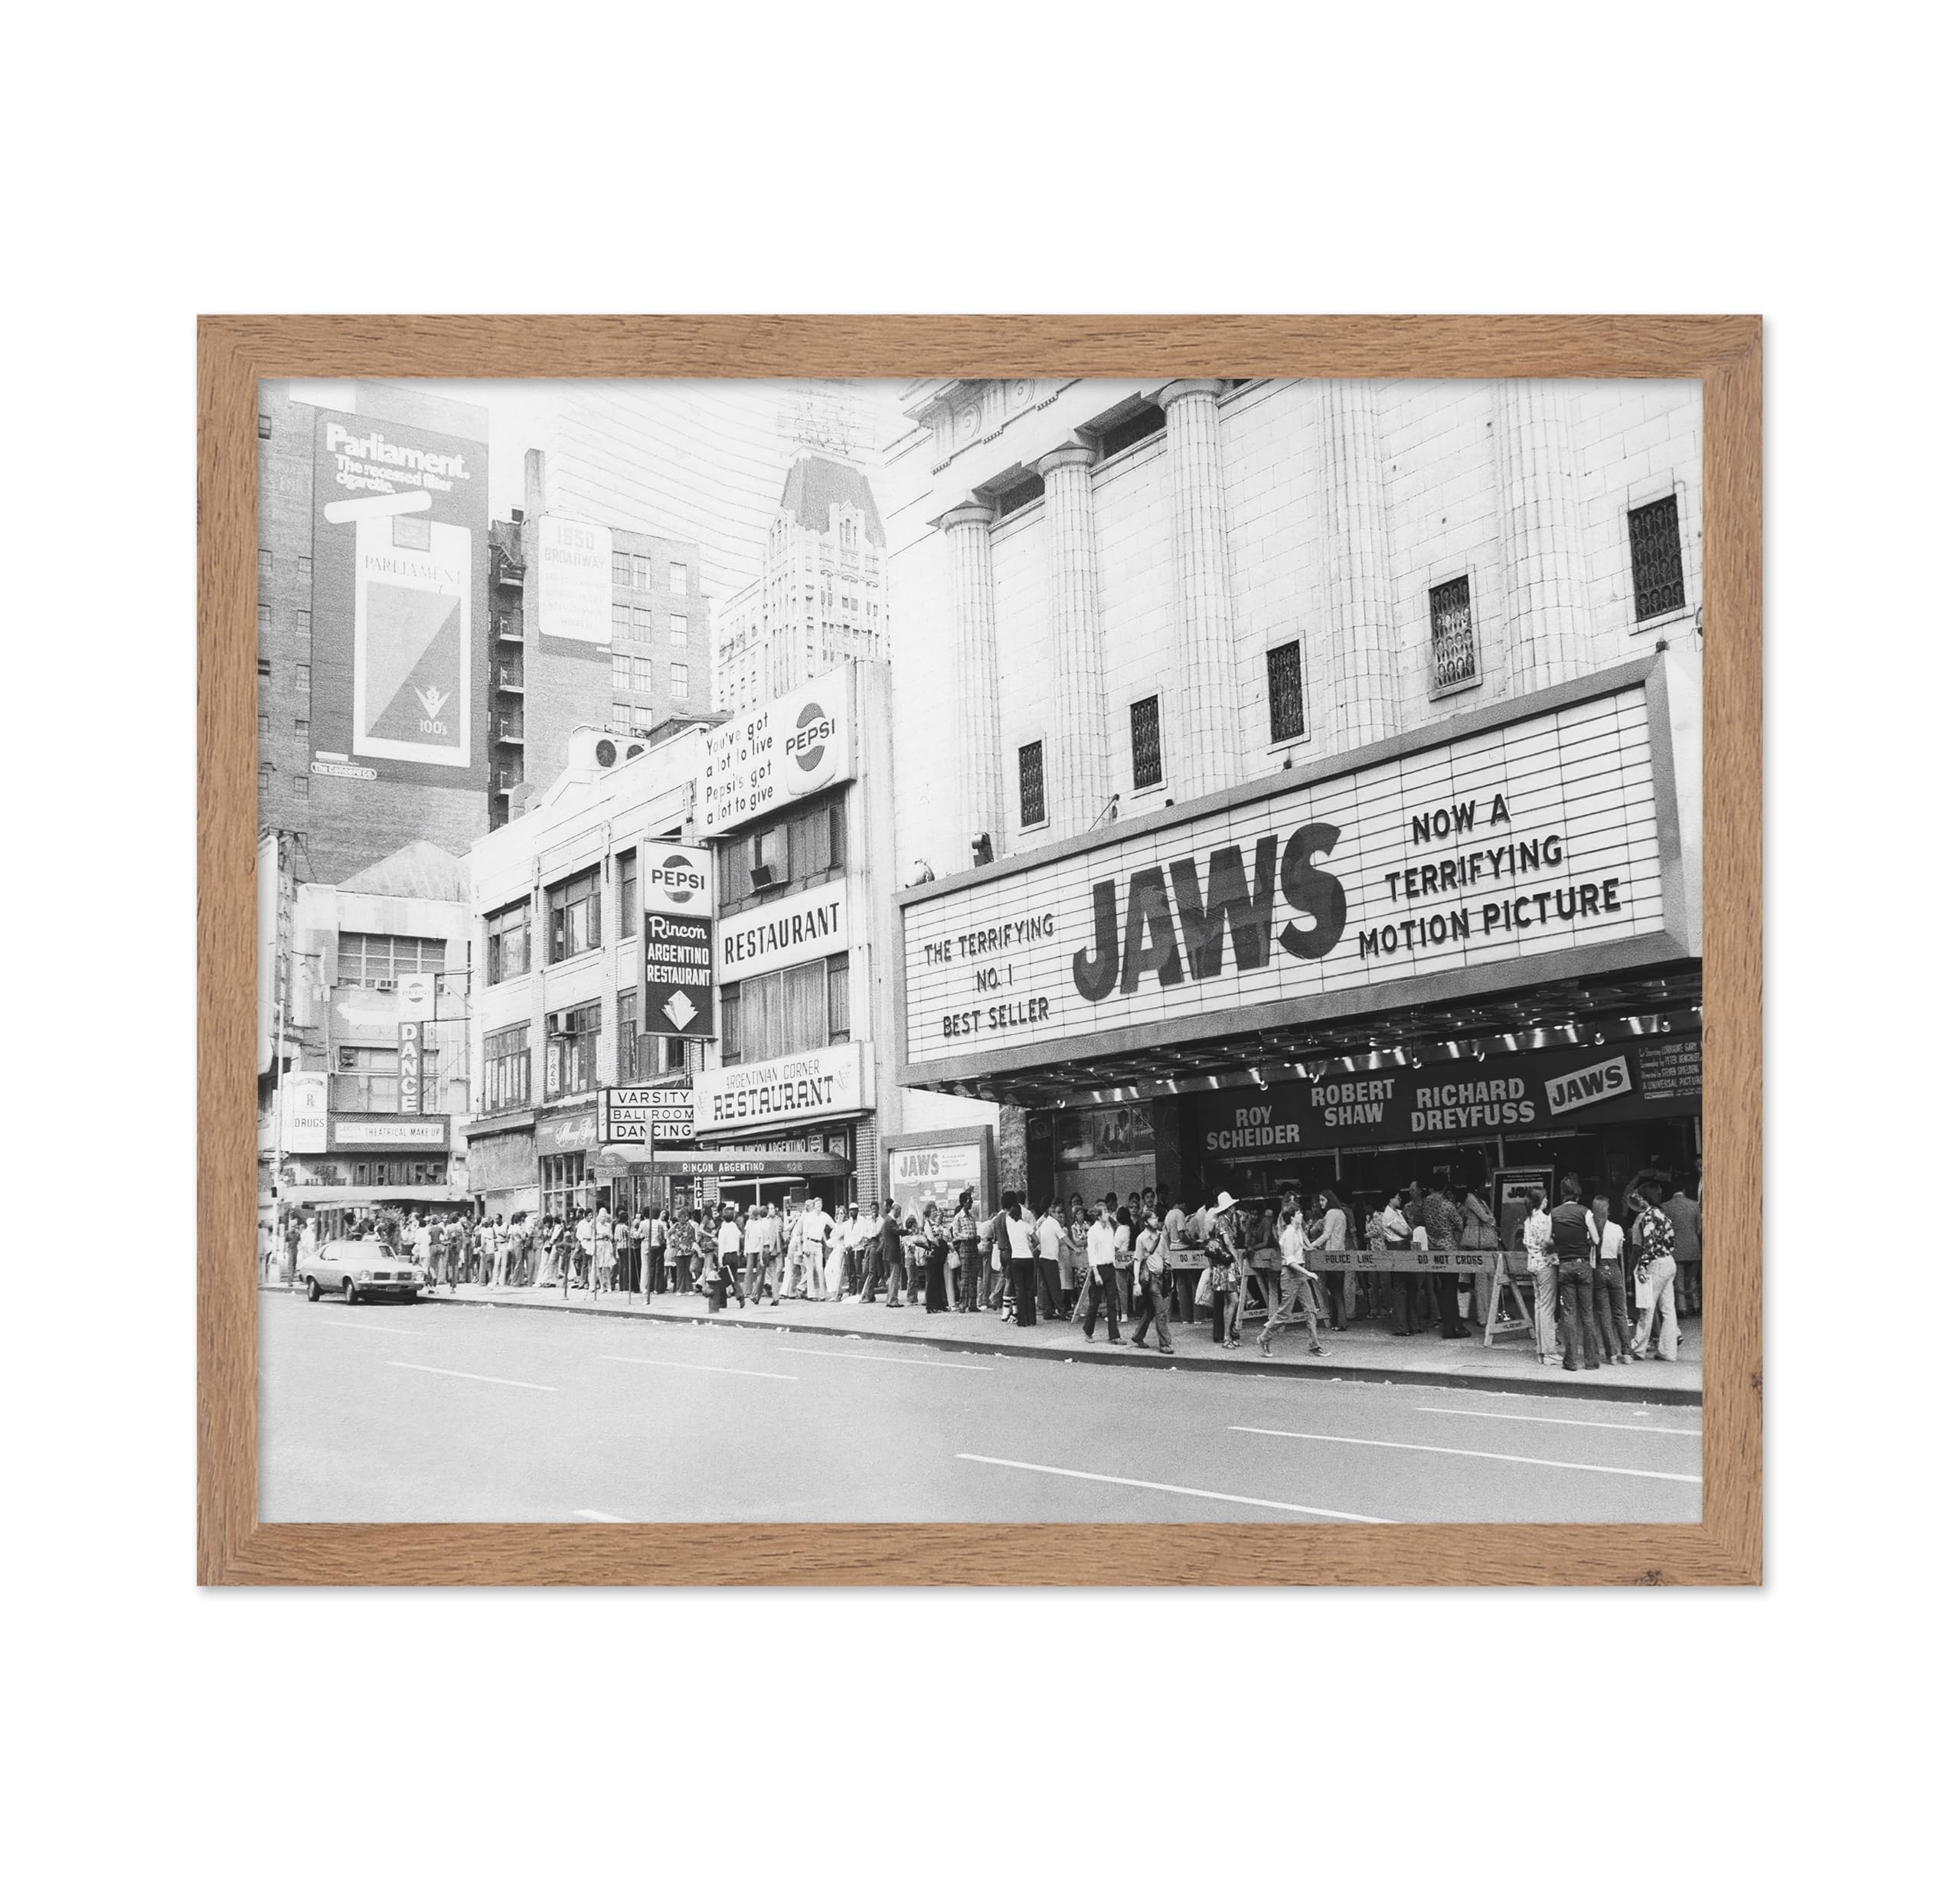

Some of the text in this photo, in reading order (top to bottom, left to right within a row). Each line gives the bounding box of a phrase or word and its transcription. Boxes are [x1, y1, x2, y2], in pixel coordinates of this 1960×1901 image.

[327, 422, 470, 479] Parliament.
[335, 454, 362, 473] The
[364, 464, 422, 486] recessed
[544, 547, 605, 570] BROADWAY
[707, 712, 768, 756] You've got
[786, 718, 835, 756] PEPSI
[706, 736, 773, 777] a lot to live
[707, 759, 772, 803] Pepsi's got
[707, 784, 773, 825] a lot to give
[1412, 793, 1511, 845] NOW A
[652, 869, 704, 890] PEPSI
[1385, 835, 1563, 902] TERRIFYING
[1073, 822, 1347, 1001] JAWS
[1359, 877, 1621, 959] MOTION PICTURE
[649, 916, 707, 939] Rincon
[725, 902, 840, 965] RESTAURANT
[924, 913, 1054, 966] THE TERRIFYING
[648, 942, 709, 965] ARGENTINO
[647, 965, 711, 986] RESTAURANT
[977, 967, 1001, 992] NO.
[943, 997, 1049, 1037] BEST SELLER
[401, 1024, 417, 1112] DANCE
[783, 1060, 819, 1080] CORNER
[617, 1092, 689, 1103] VARSITY
[714, 1075, 833, 1121] RESTAURANT
[1311, 1079, 1395, 1107] ROBERT
[1416, 1077, 1525, 1109] RICHARD
[1553, 1065, 1623, 1107] JAWS
[295, 1118, 325, 1128] DRUGS
[613, 1110, 694, 1119] BALLROOM
[1236, 1106, 1272, 1128] ROY
[1325, 1102, 1383, 1127] SHAW
[1411, 1101, 1536, 1132] DREYFUSS
[410, 1128, 428, 1137] MAKE
[430, 1128, 440, 1137] UP
[616, 1125, 691, 1138] DANCING
[1206, 1123, 1300, 1150] SCHEIDER
[682, 1162, 714, 1172] RINCON
[718, 1162, 764, 1172] ARGENTINO
[900, 1153, 940, 1178] JAWS
[1180, 1254, 1188, 1262] DO
[1192, 1254, 1204, 1262] NOT
[1325, 1254, 1351, 1263] POLICE
[1357, 1254, 1374, 1263] LINE
[1417, 1254, 1429, 1264] DO
[1433, 1254, 1449, 1264] NOT
